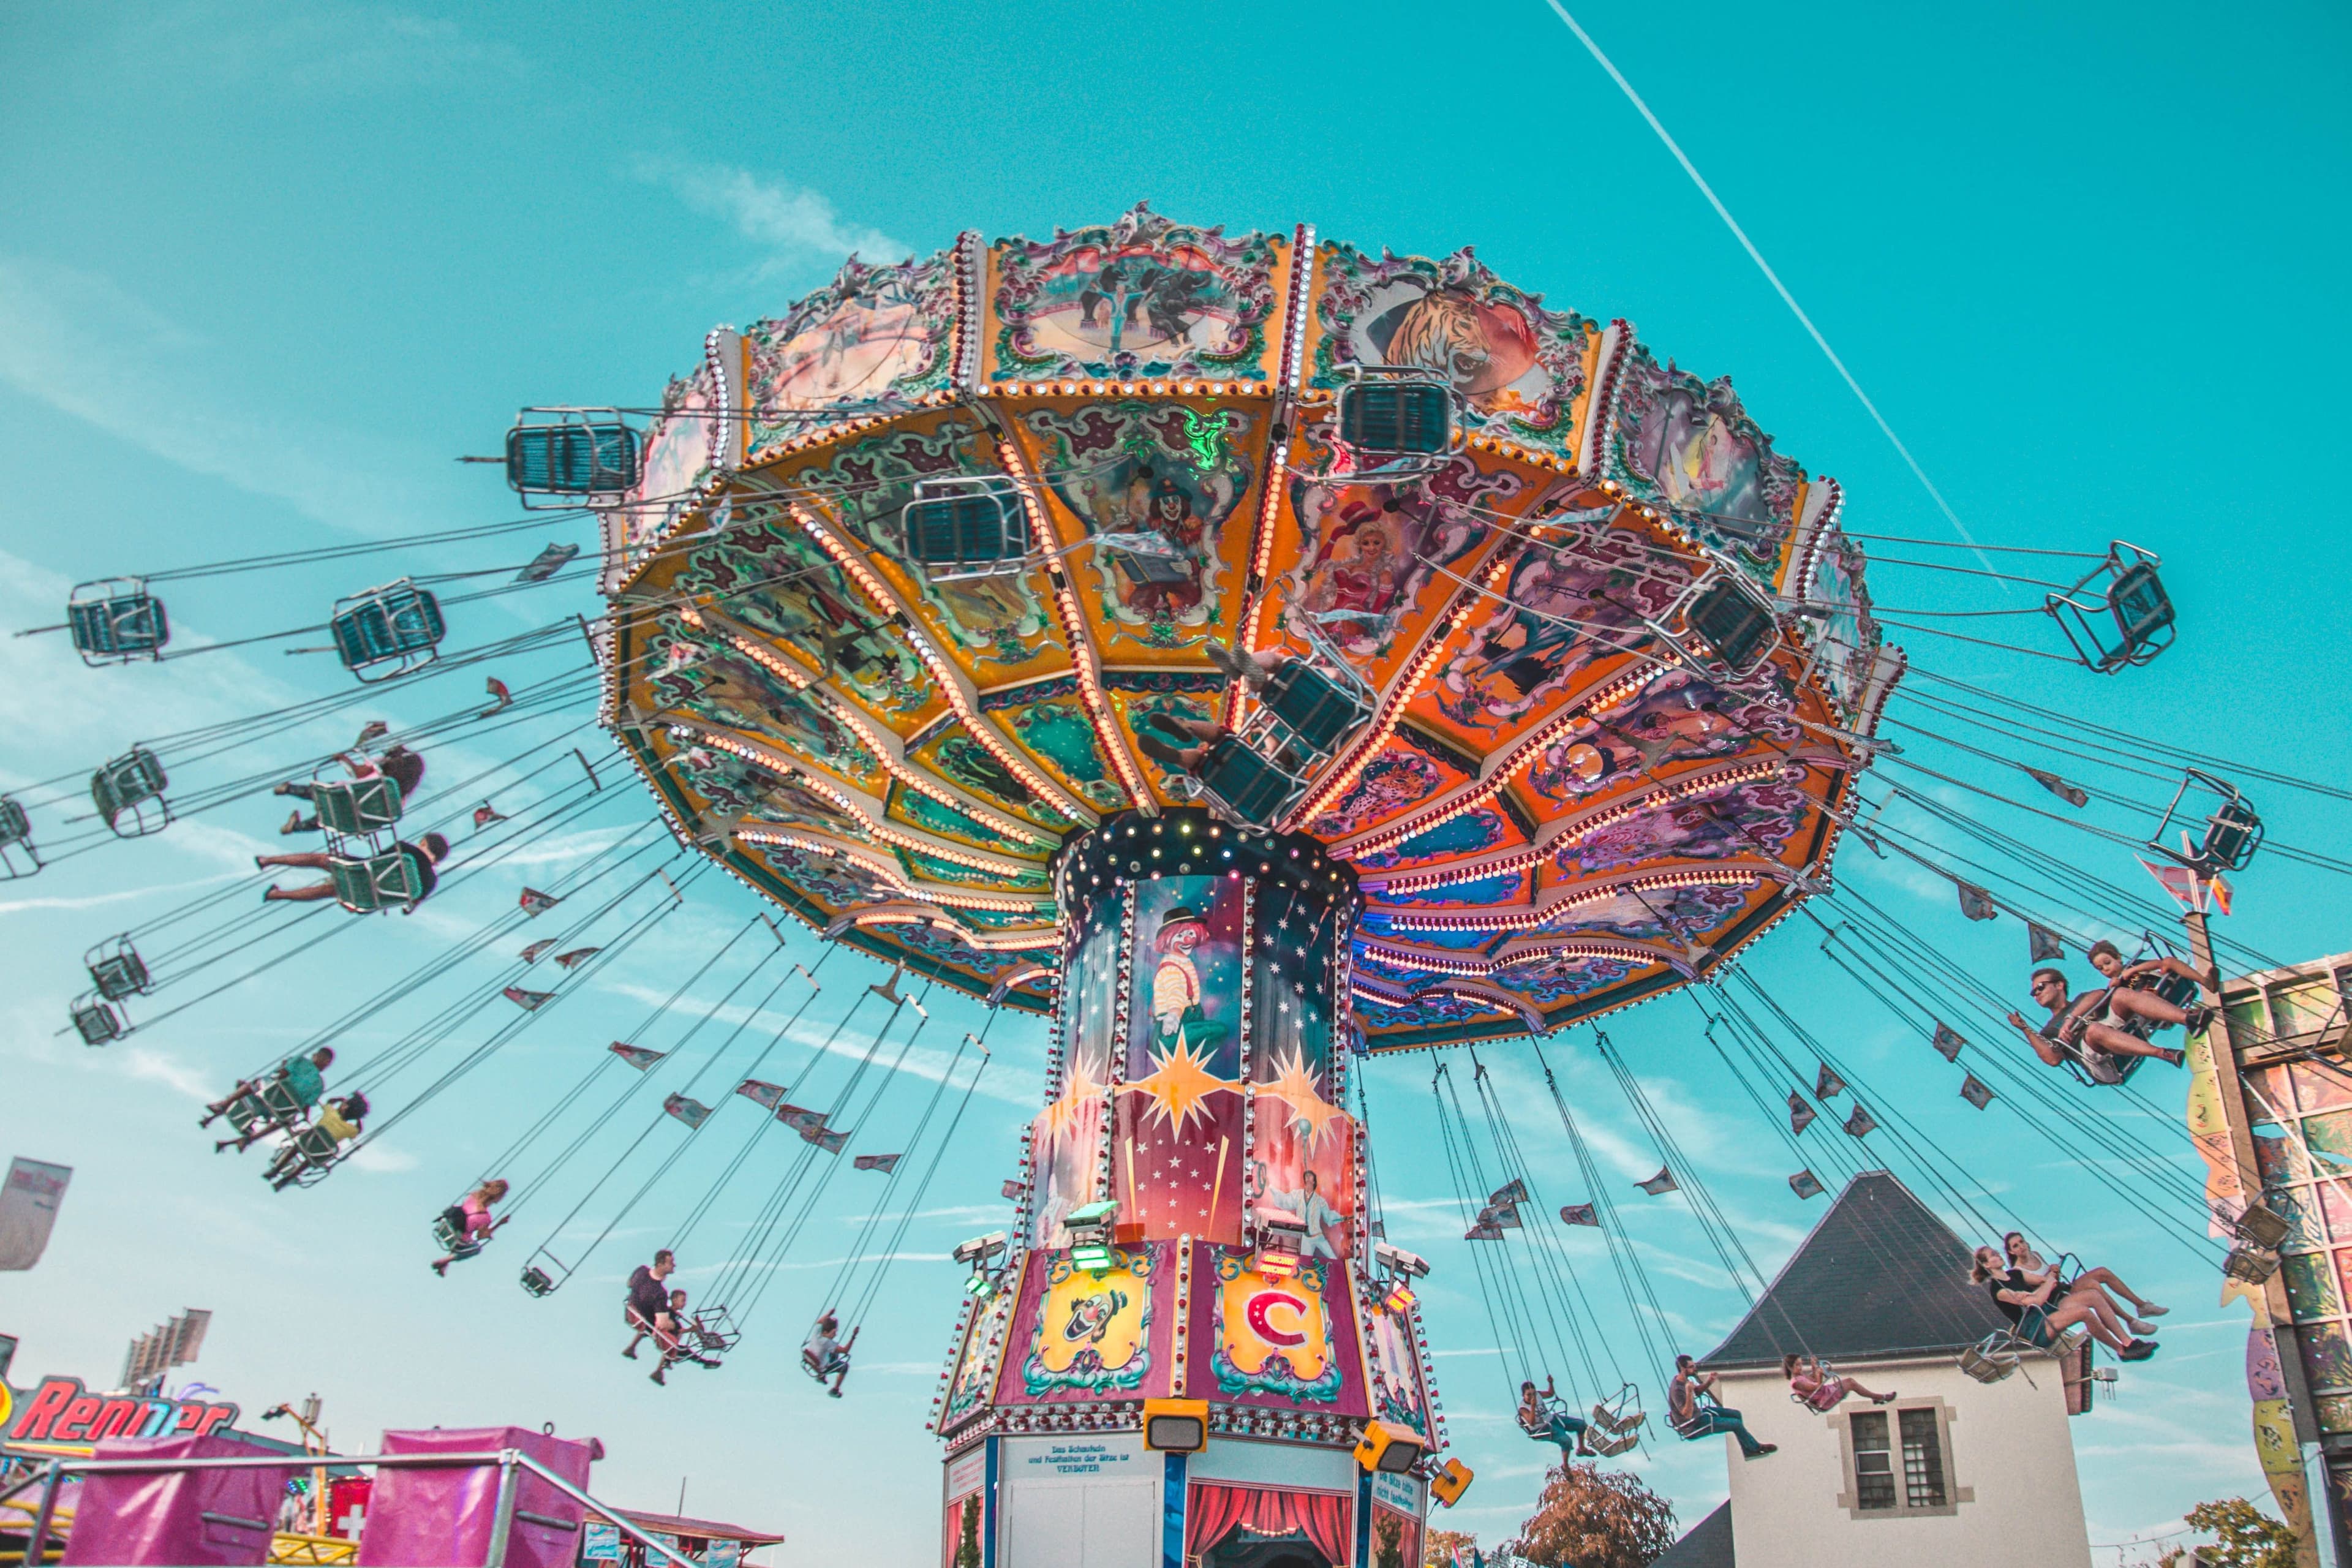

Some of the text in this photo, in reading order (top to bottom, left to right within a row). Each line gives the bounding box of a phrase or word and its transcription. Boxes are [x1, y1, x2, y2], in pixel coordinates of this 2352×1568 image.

[9, 1379, 231, 1441] Renner
[1052, 1444, 1106, 1454] Das Schaukeln
[1028, 1455, 1042, 1464] und
[1045, 1455, 1082, 1463] Festhalten
[1084, 1454, 1096, 1463] der
[1099, 1453, 1118, 1462] Sitze
[1057, 1464, 1100, 1473] VERBOTEN
